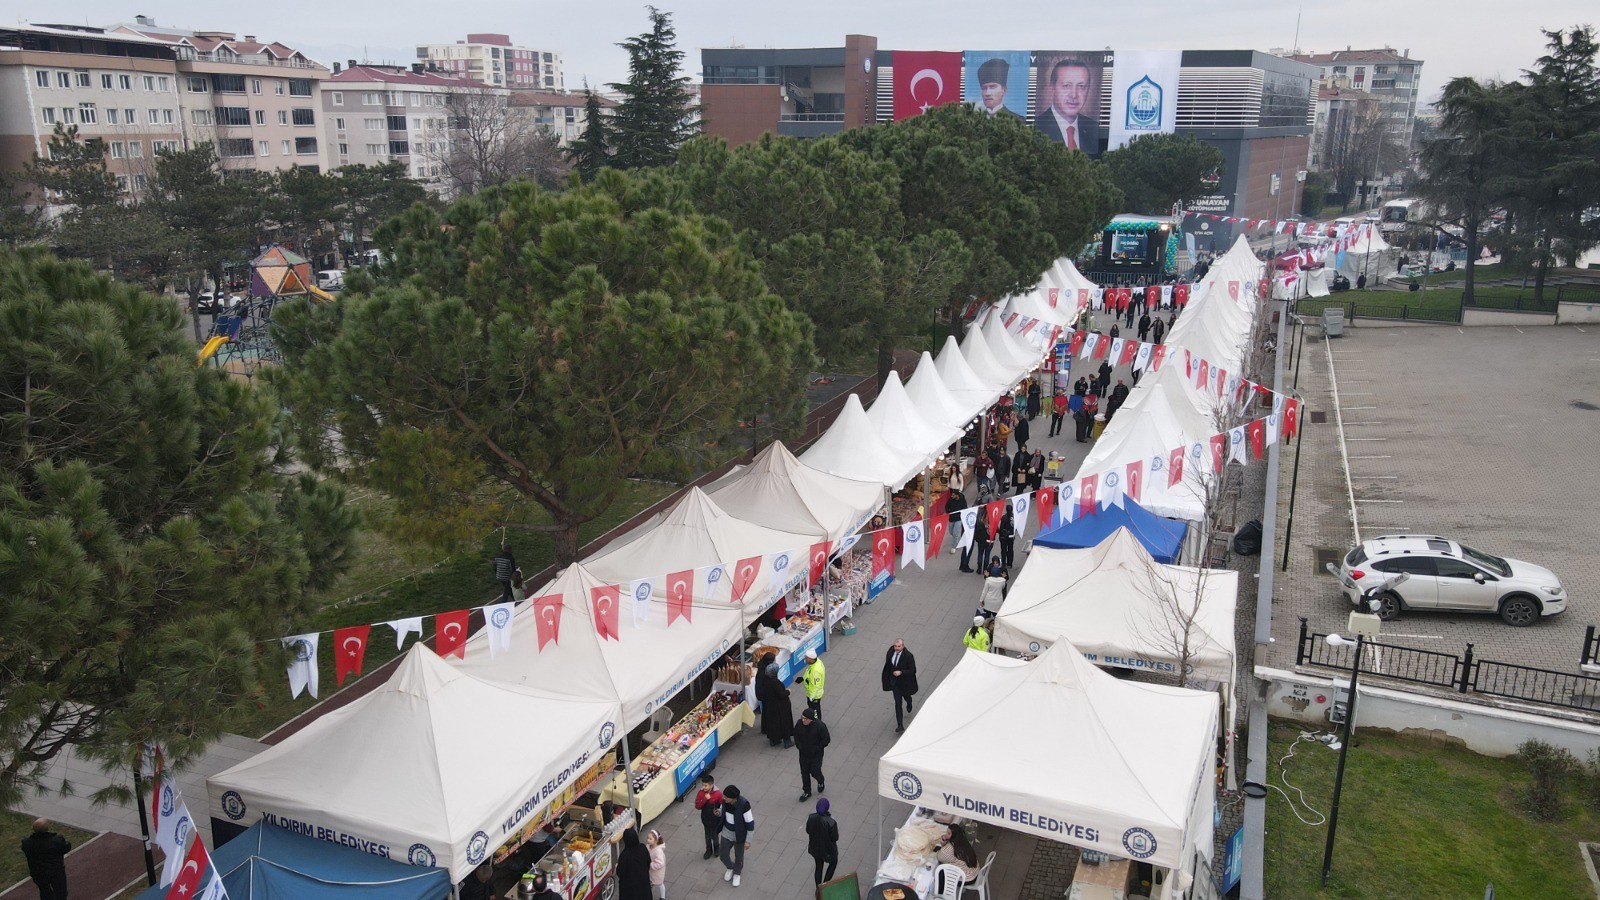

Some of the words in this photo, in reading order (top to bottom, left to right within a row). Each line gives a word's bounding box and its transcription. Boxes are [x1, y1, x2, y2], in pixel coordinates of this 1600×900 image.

[502, 792, 540, 834] YILDIRIM
[942, 793, 1005, 819] YILDIRIM
[262, 811, 314, 837] YILDIRIM
